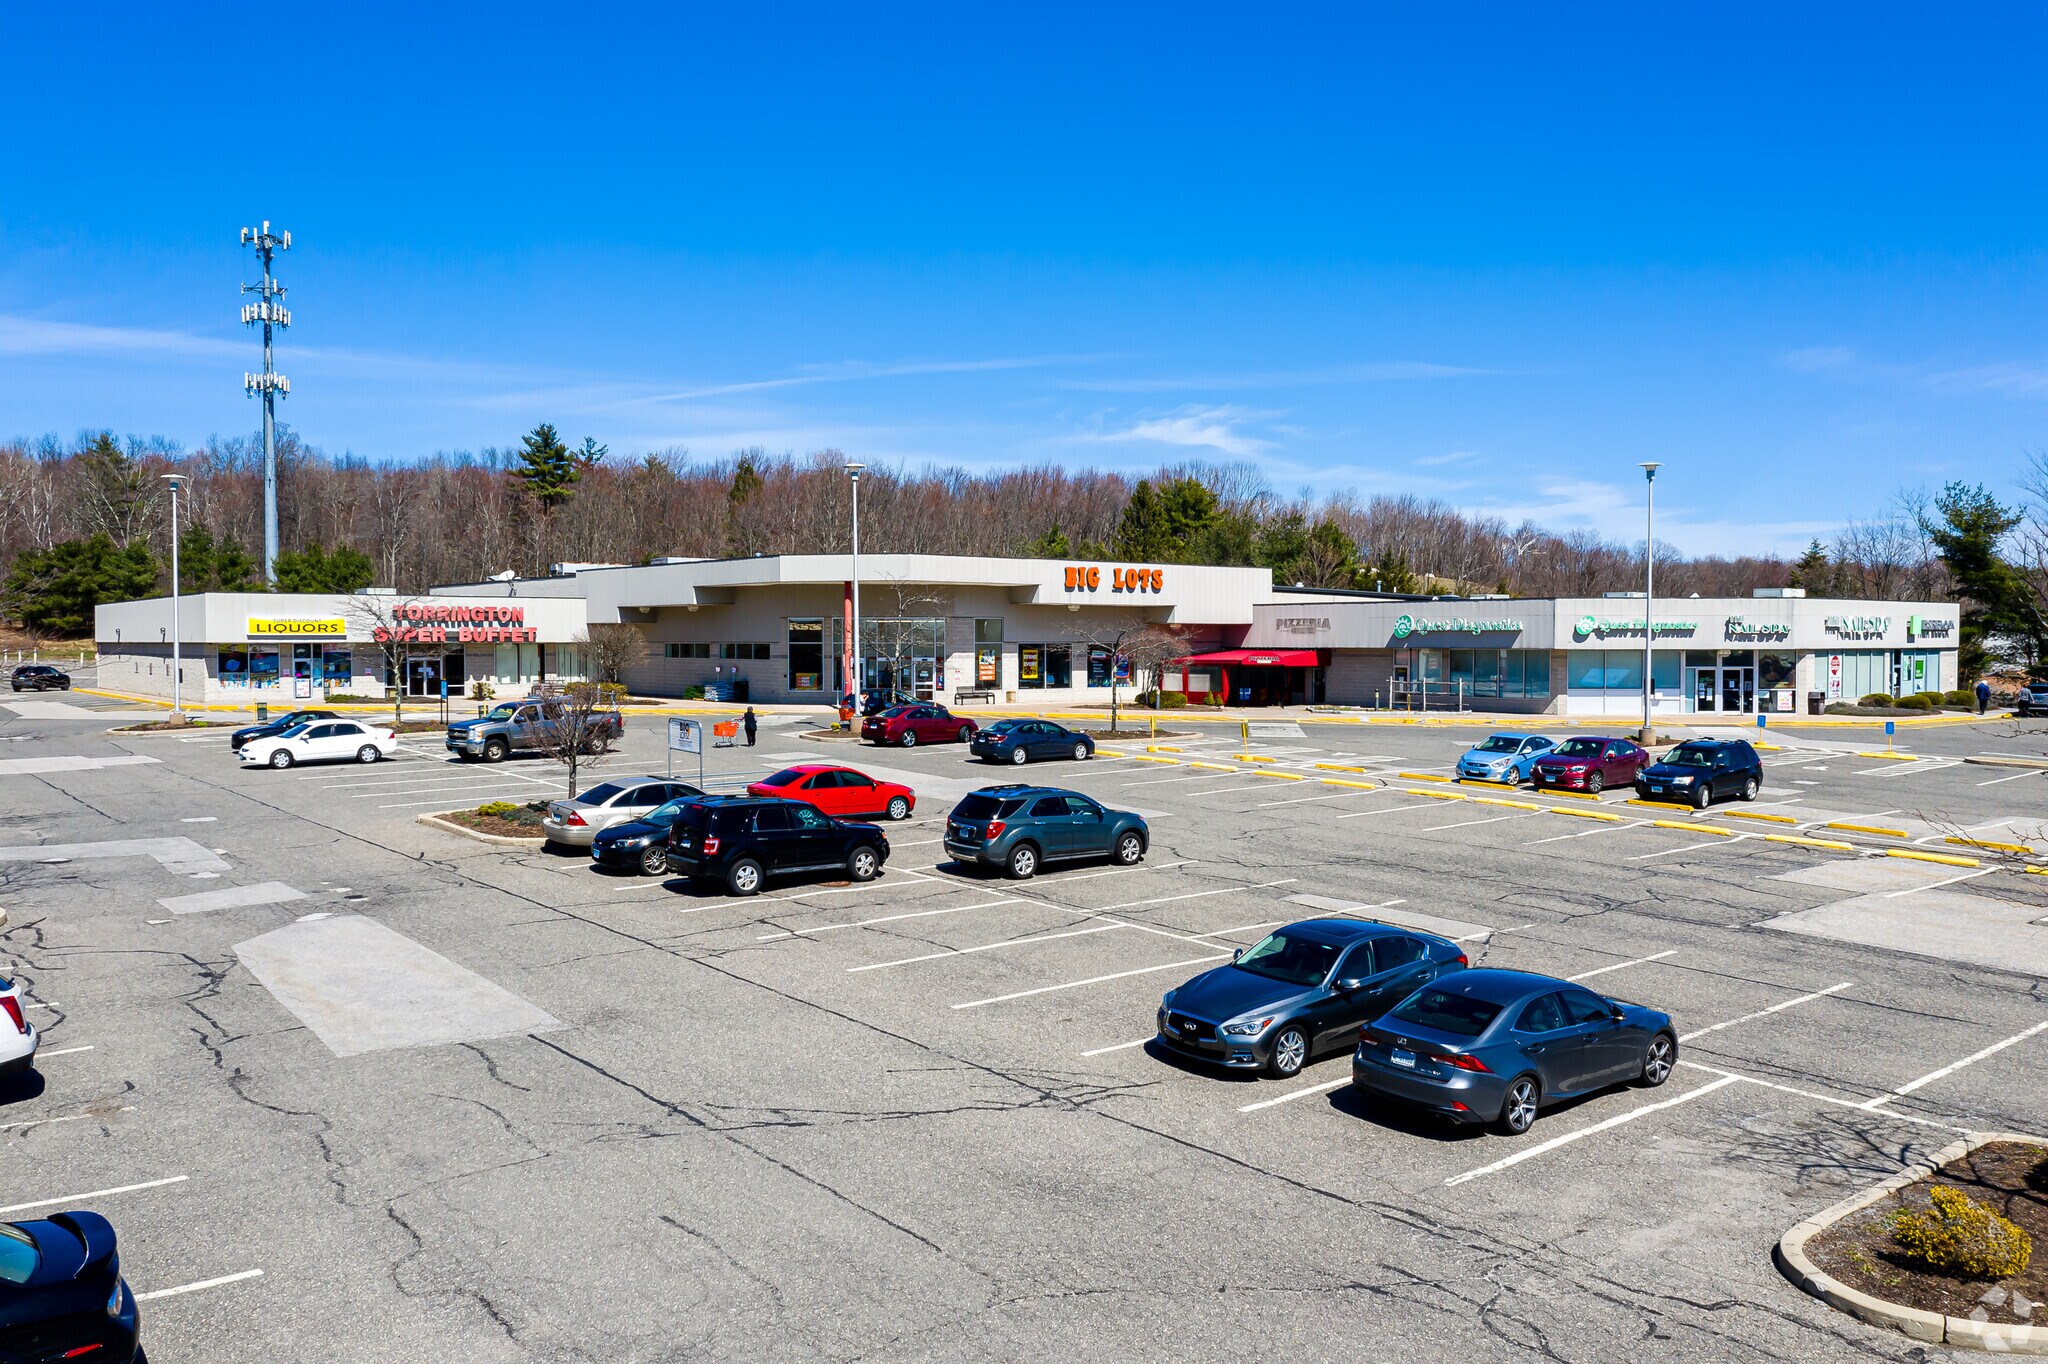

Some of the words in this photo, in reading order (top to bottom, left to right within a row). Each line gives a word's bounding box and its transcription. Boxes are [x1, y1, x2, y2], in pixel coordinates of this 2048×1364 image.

[1065, 567, 1100, 588] BIG
[1112, 568, 1163, 589] LOTS
[393, 605, 524, 622] TORRINGTON
[256, 623, 338, 633] LIQUORS
[1276, 618, 1331, 630] PIZZERIA
[1632, 619, 1699, 632] Dignostics
[1729, 624, 1760, 633] NAIL
[1761, 624, 1789, 633] SPA
[373, 626, 446, 642] SUPER
[458, 627, 537, 642] BUFFET
